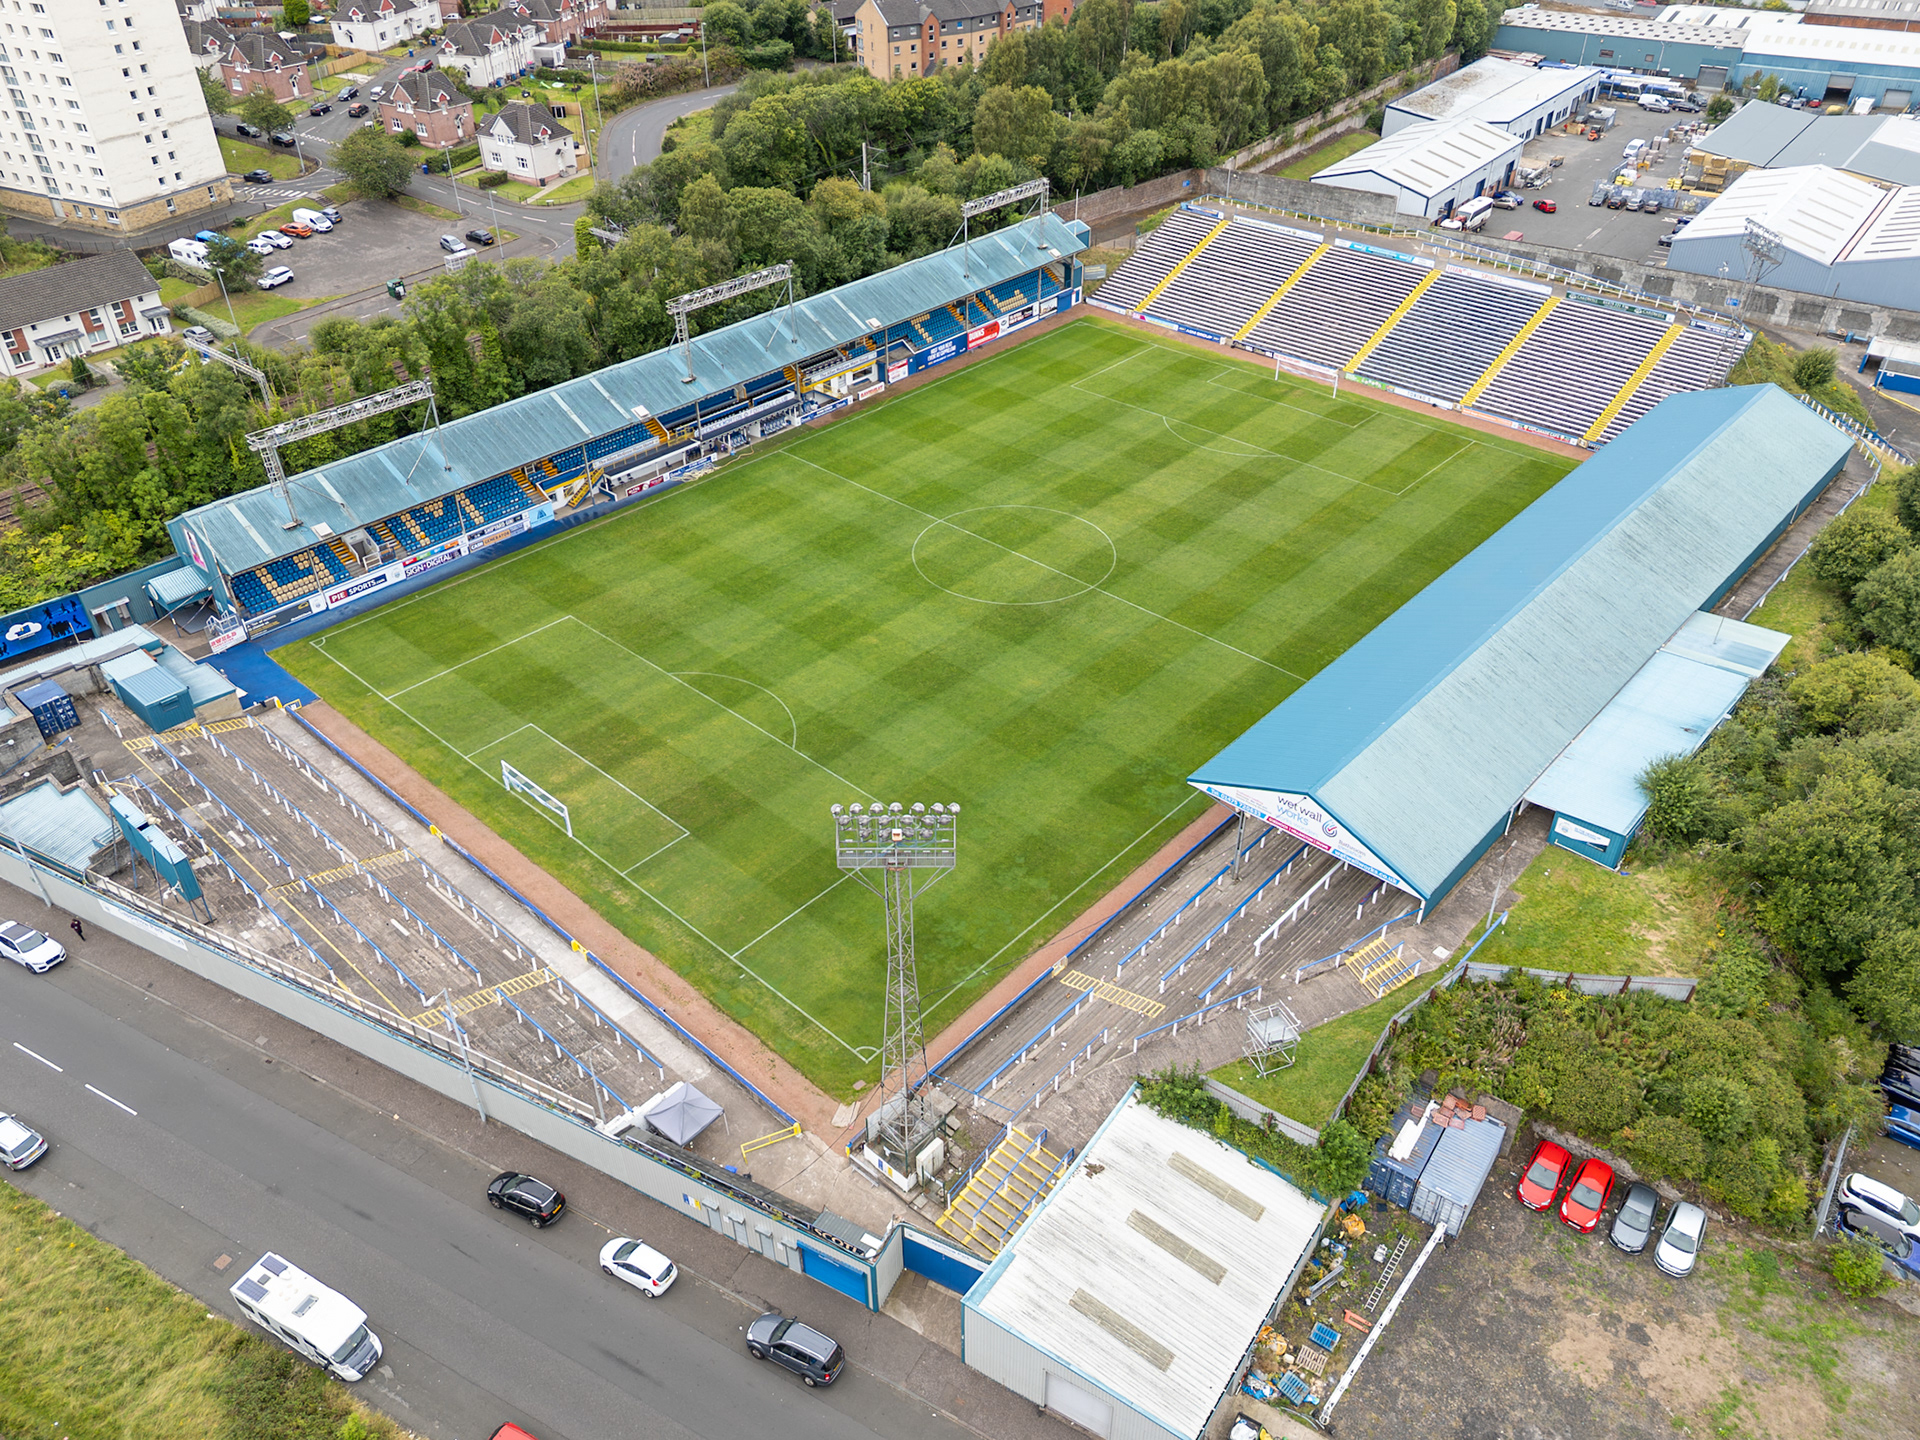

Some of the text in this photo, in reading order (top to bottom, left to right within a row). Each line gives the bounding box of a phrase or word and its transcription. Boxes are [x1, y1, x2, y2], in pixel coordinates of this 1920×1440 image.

[405, 552, 453, 577] SIGN DIGITAL
[331, 592, 346, 602] PIE
[1277, 805, 1309, 826] works
[1278, 796, 1297, 811] wet
[1300, 806, 1322, 823] wall
